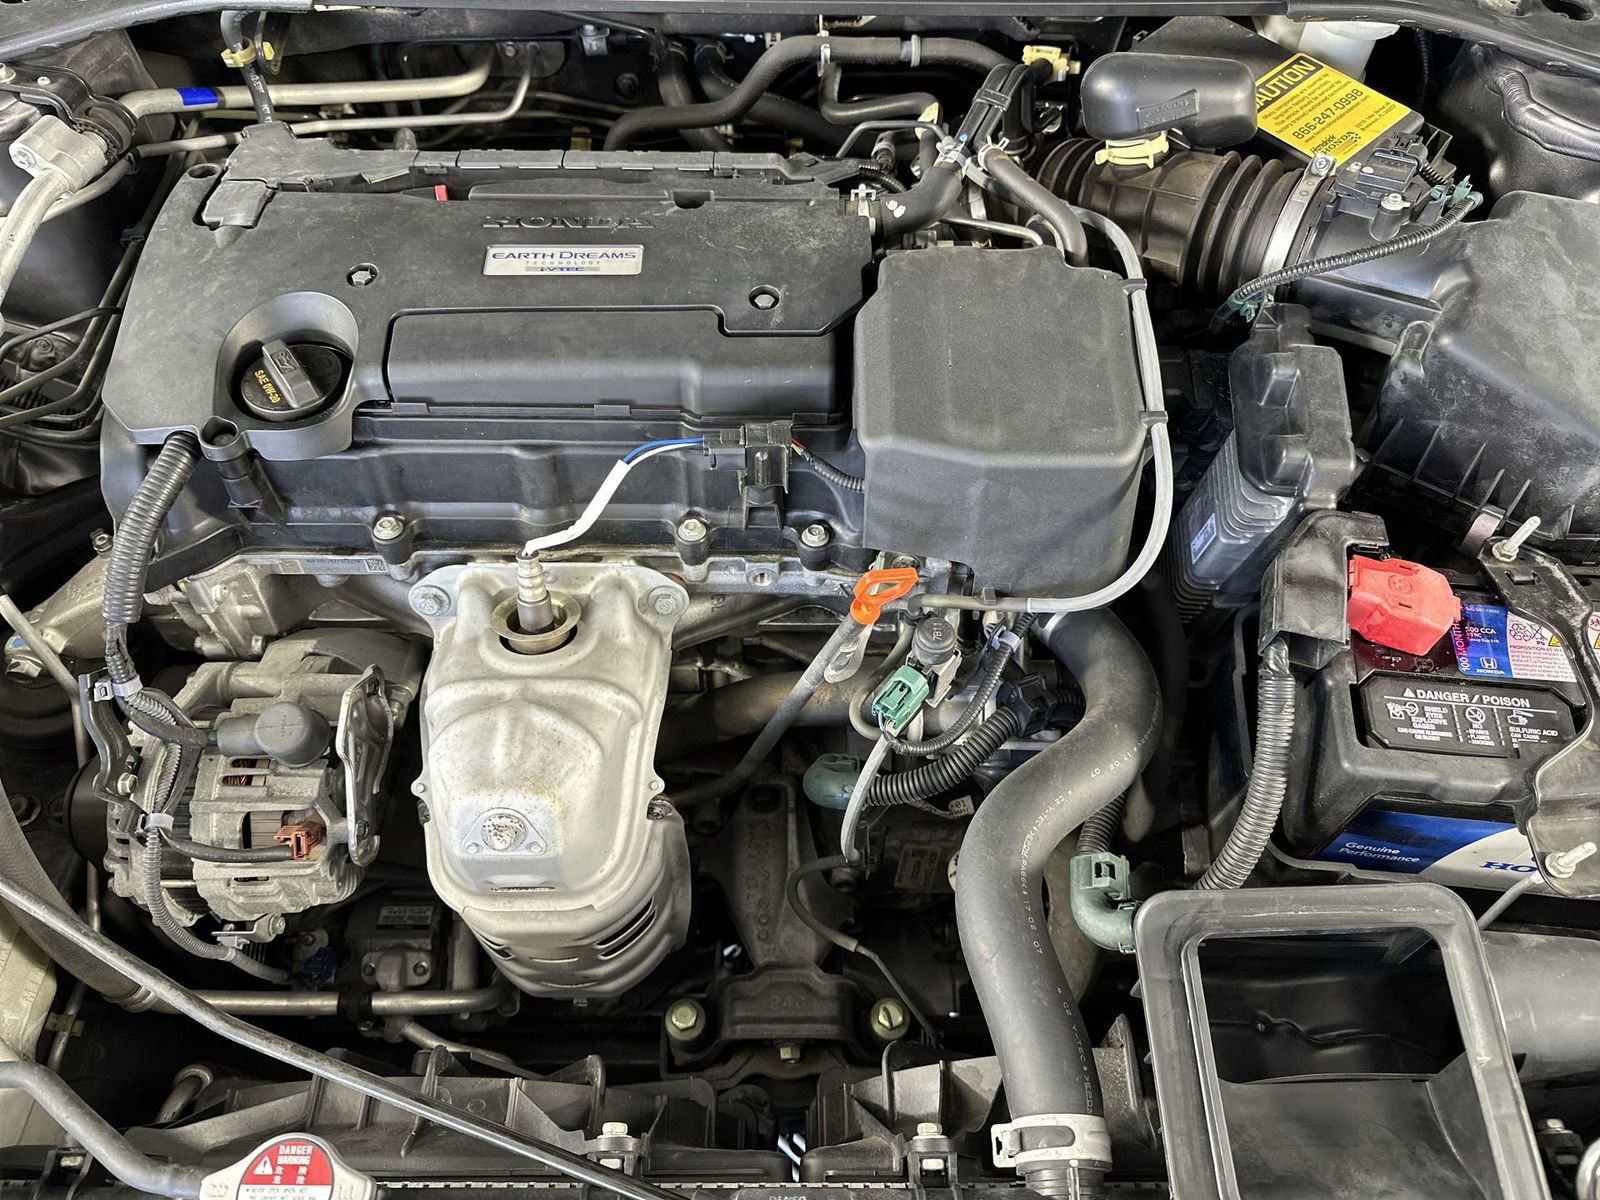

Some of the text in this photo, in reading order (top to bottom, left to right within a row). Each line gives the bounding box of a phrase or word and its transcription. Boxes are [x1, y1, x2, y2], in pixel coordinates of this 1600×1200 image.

[1256, 60, 1316, 109] AUTION
[1292, 88, 1364, 139] 866-247-0998
[1321, 129, 1354, 154] HONDA
[483, 215, 656, 229] HONDA
[492, 250, 637, 260] EARTH DREAMS
[254, 369, 281, 404] SAE 0W-20
[1480, 627, 1497, 635] CCA
[1451, 618, 1471, 672] 100 MONTH
[1416, 689, 1471, 703] DANGER
[1482, 694, 1531, 708] POISON
[1423, 705, 1448, 714] SHIELD
[1411, 715, 1448, 726] EXPLOSIVE
[1412, 722, 1436, 730] GASES
[1509, 726, 1559, 737] SULFURIC ACID
[1338, 841, 1420, 863] Genuine Performance
[1480, 861, 1537, 873] HO
[278, 1145, 313, 1155] DANGER
[277, 1155, 311, 1165] WARNING
